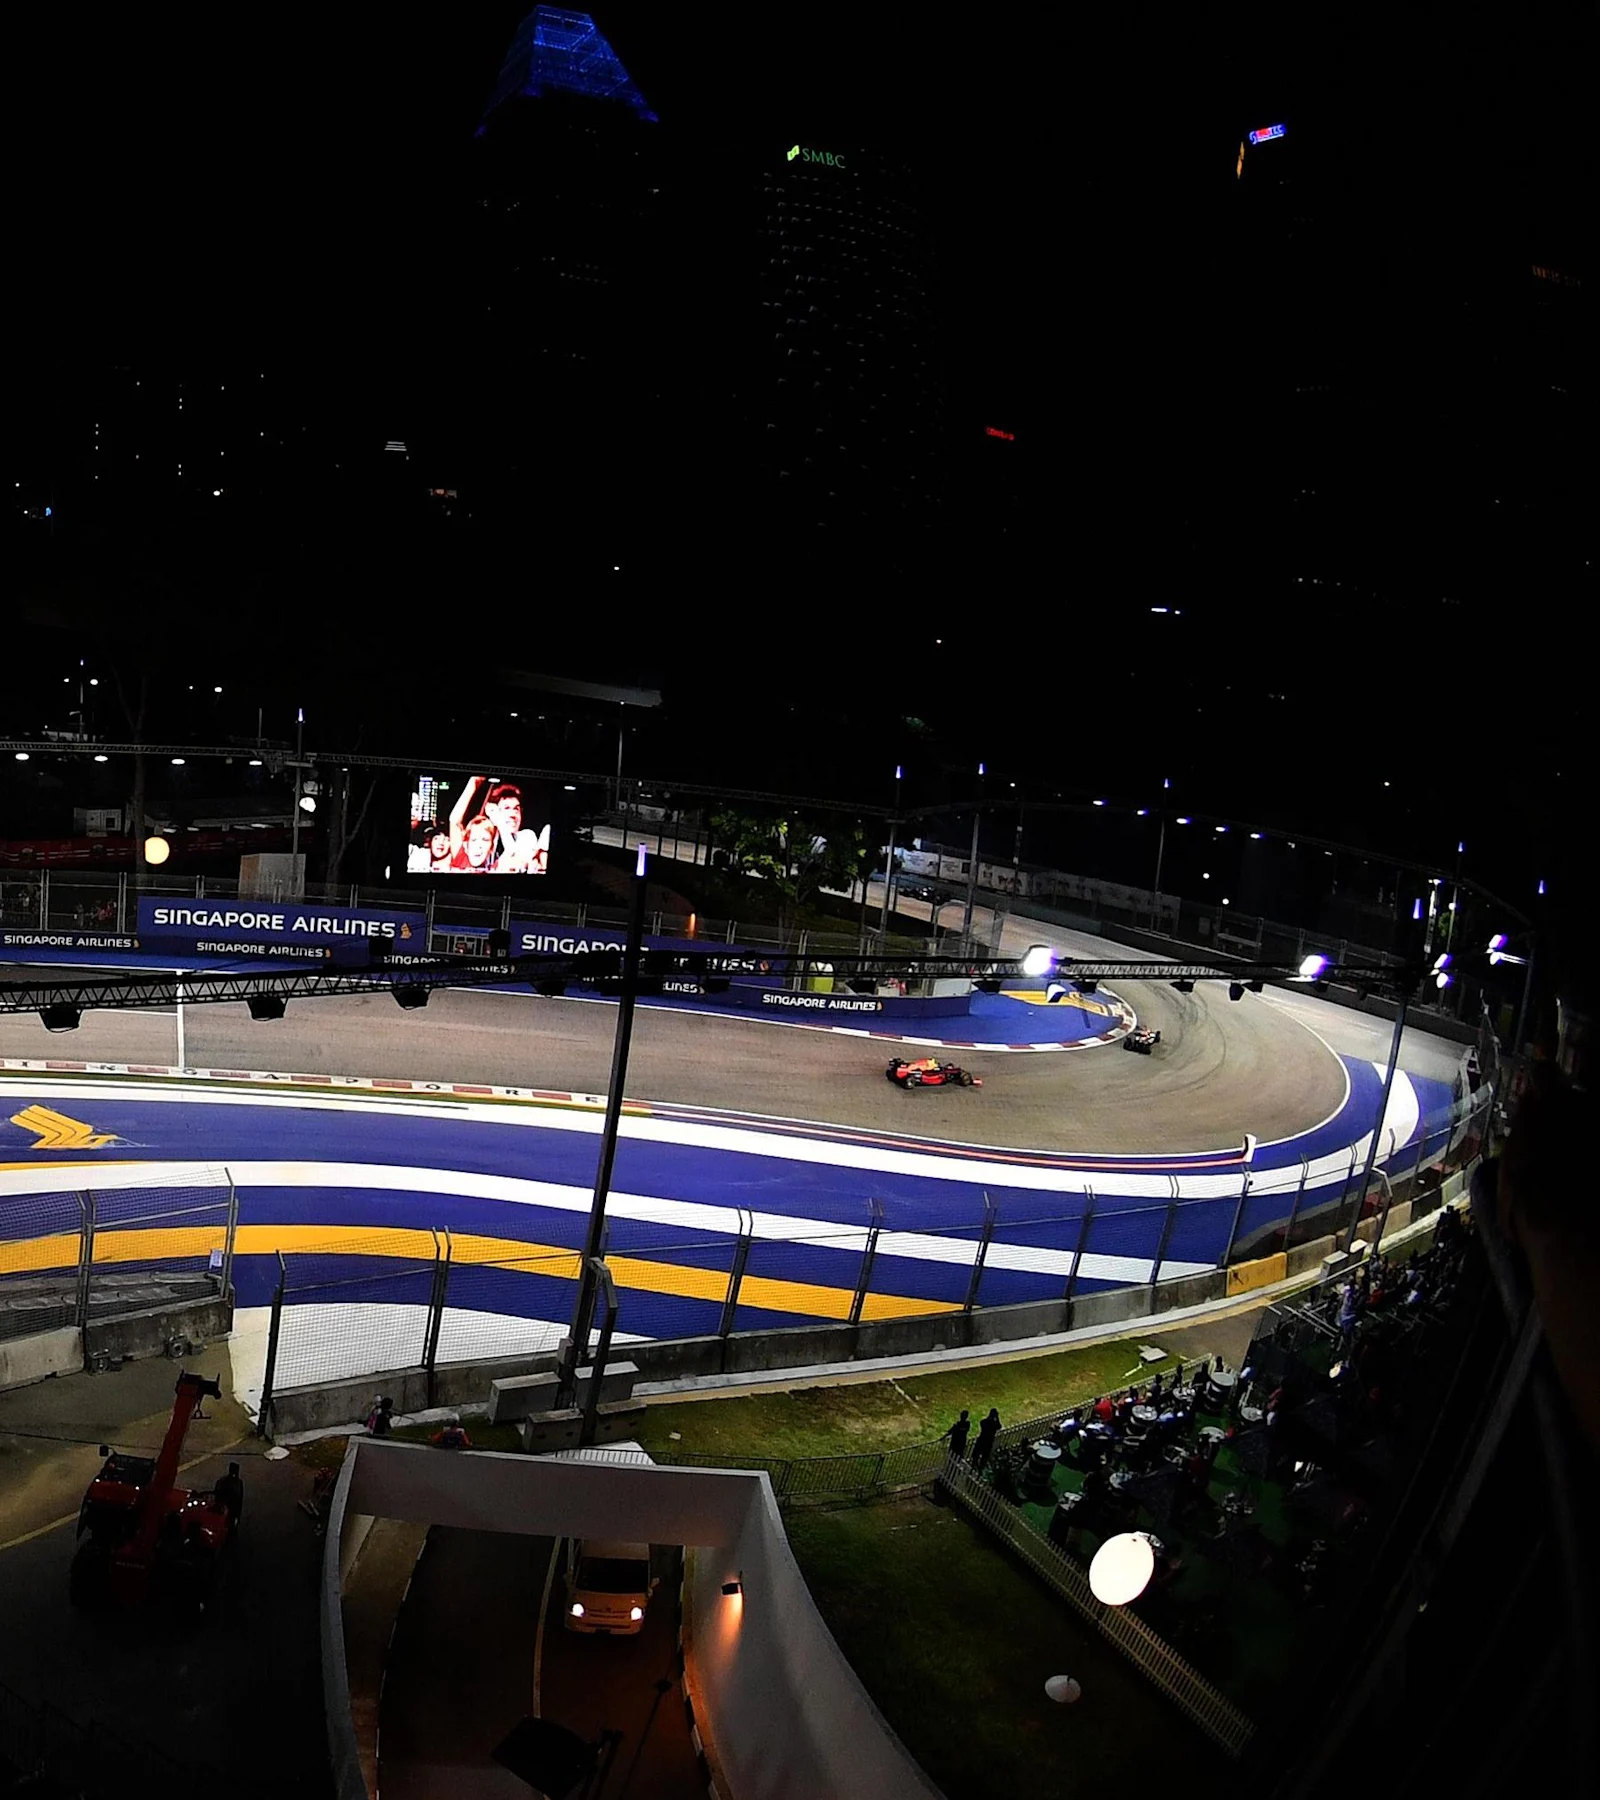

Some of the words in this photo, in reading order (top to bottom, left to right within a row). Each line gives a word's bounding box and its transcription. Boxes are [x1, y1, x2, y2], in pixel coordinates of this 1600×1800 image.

[802, 148, 846, 168] SMBC
[153, 907, 286, 931] SINGAPORE
[291, 915, 397, 938] AIRLINES
[4, 934, 74, 947] SINGAPORE
[76, 936, 132, 949] AIRLINES
[196, 941, 266, 955] SINGAPORE
[268, 947, 324, 959] AIRLINES
[762, 993, 827, 1008] SINGAPORE
[828, 999, 877, 1011] AIRLINES
